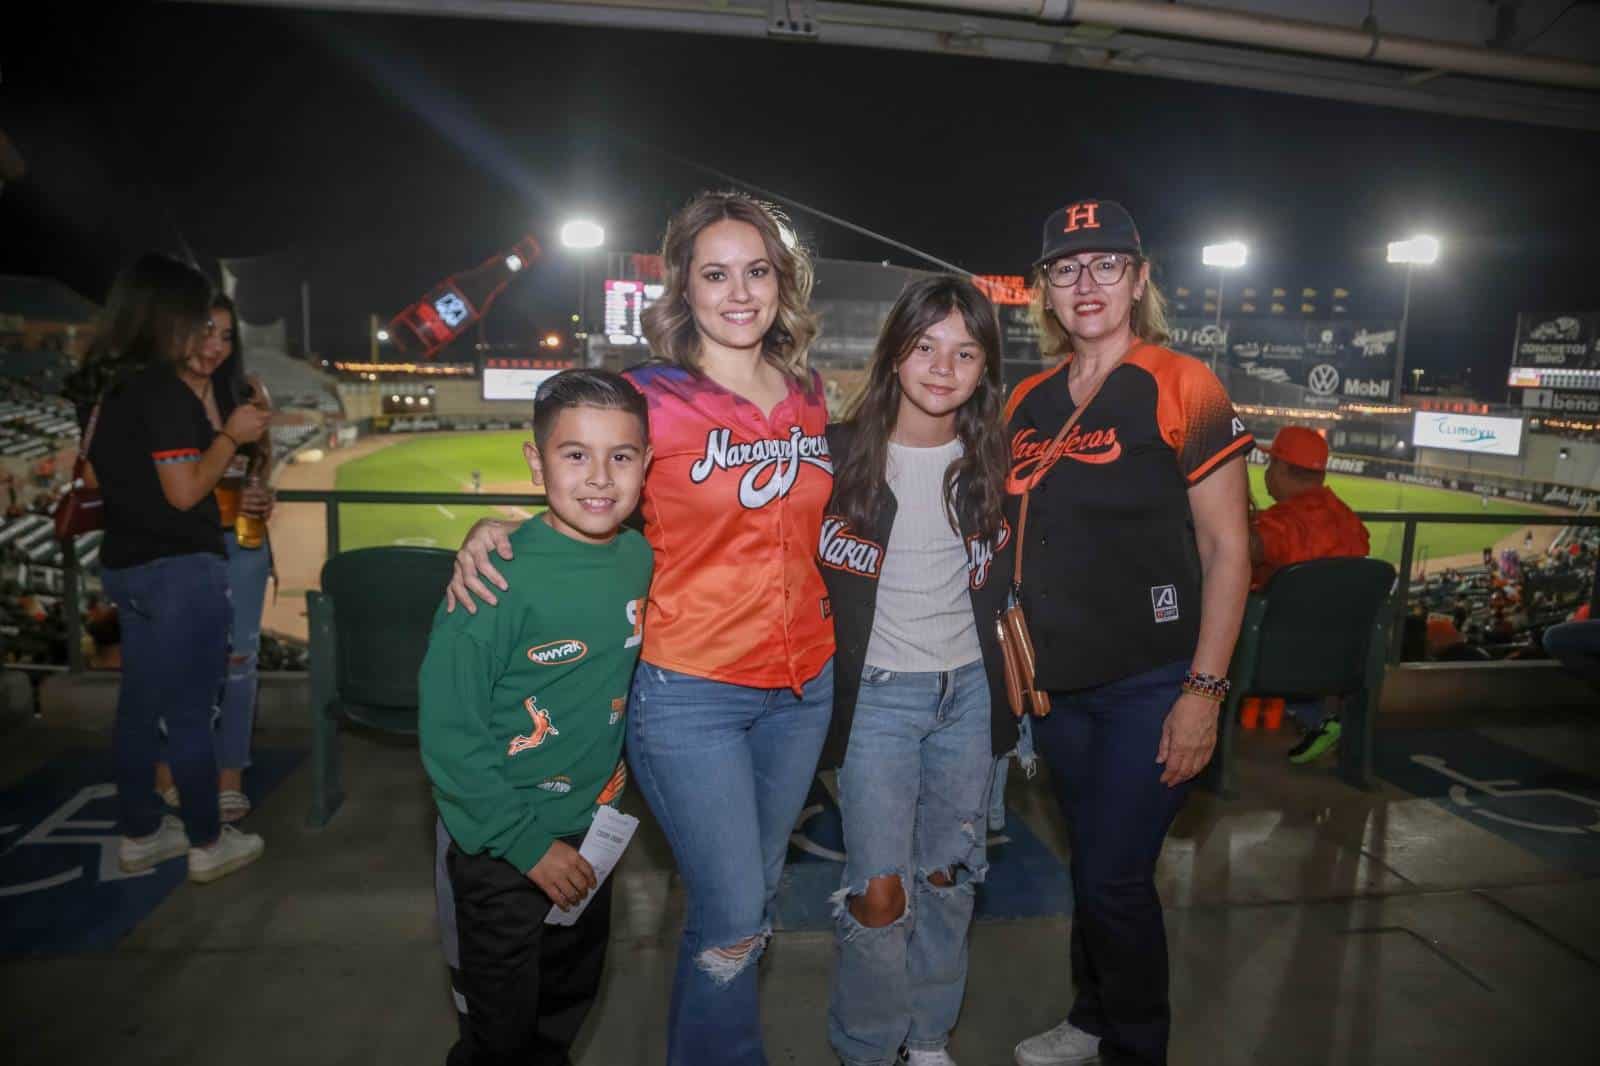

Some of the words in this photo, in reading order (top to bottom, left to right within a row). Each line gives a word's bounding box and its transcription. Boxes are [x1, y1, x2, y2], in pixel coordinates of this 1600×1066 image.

[1063, 202, 1101, 233] H
[1344, 378, 1391, 398] Mobil
[531, 641, 582, 662] NWYRK
